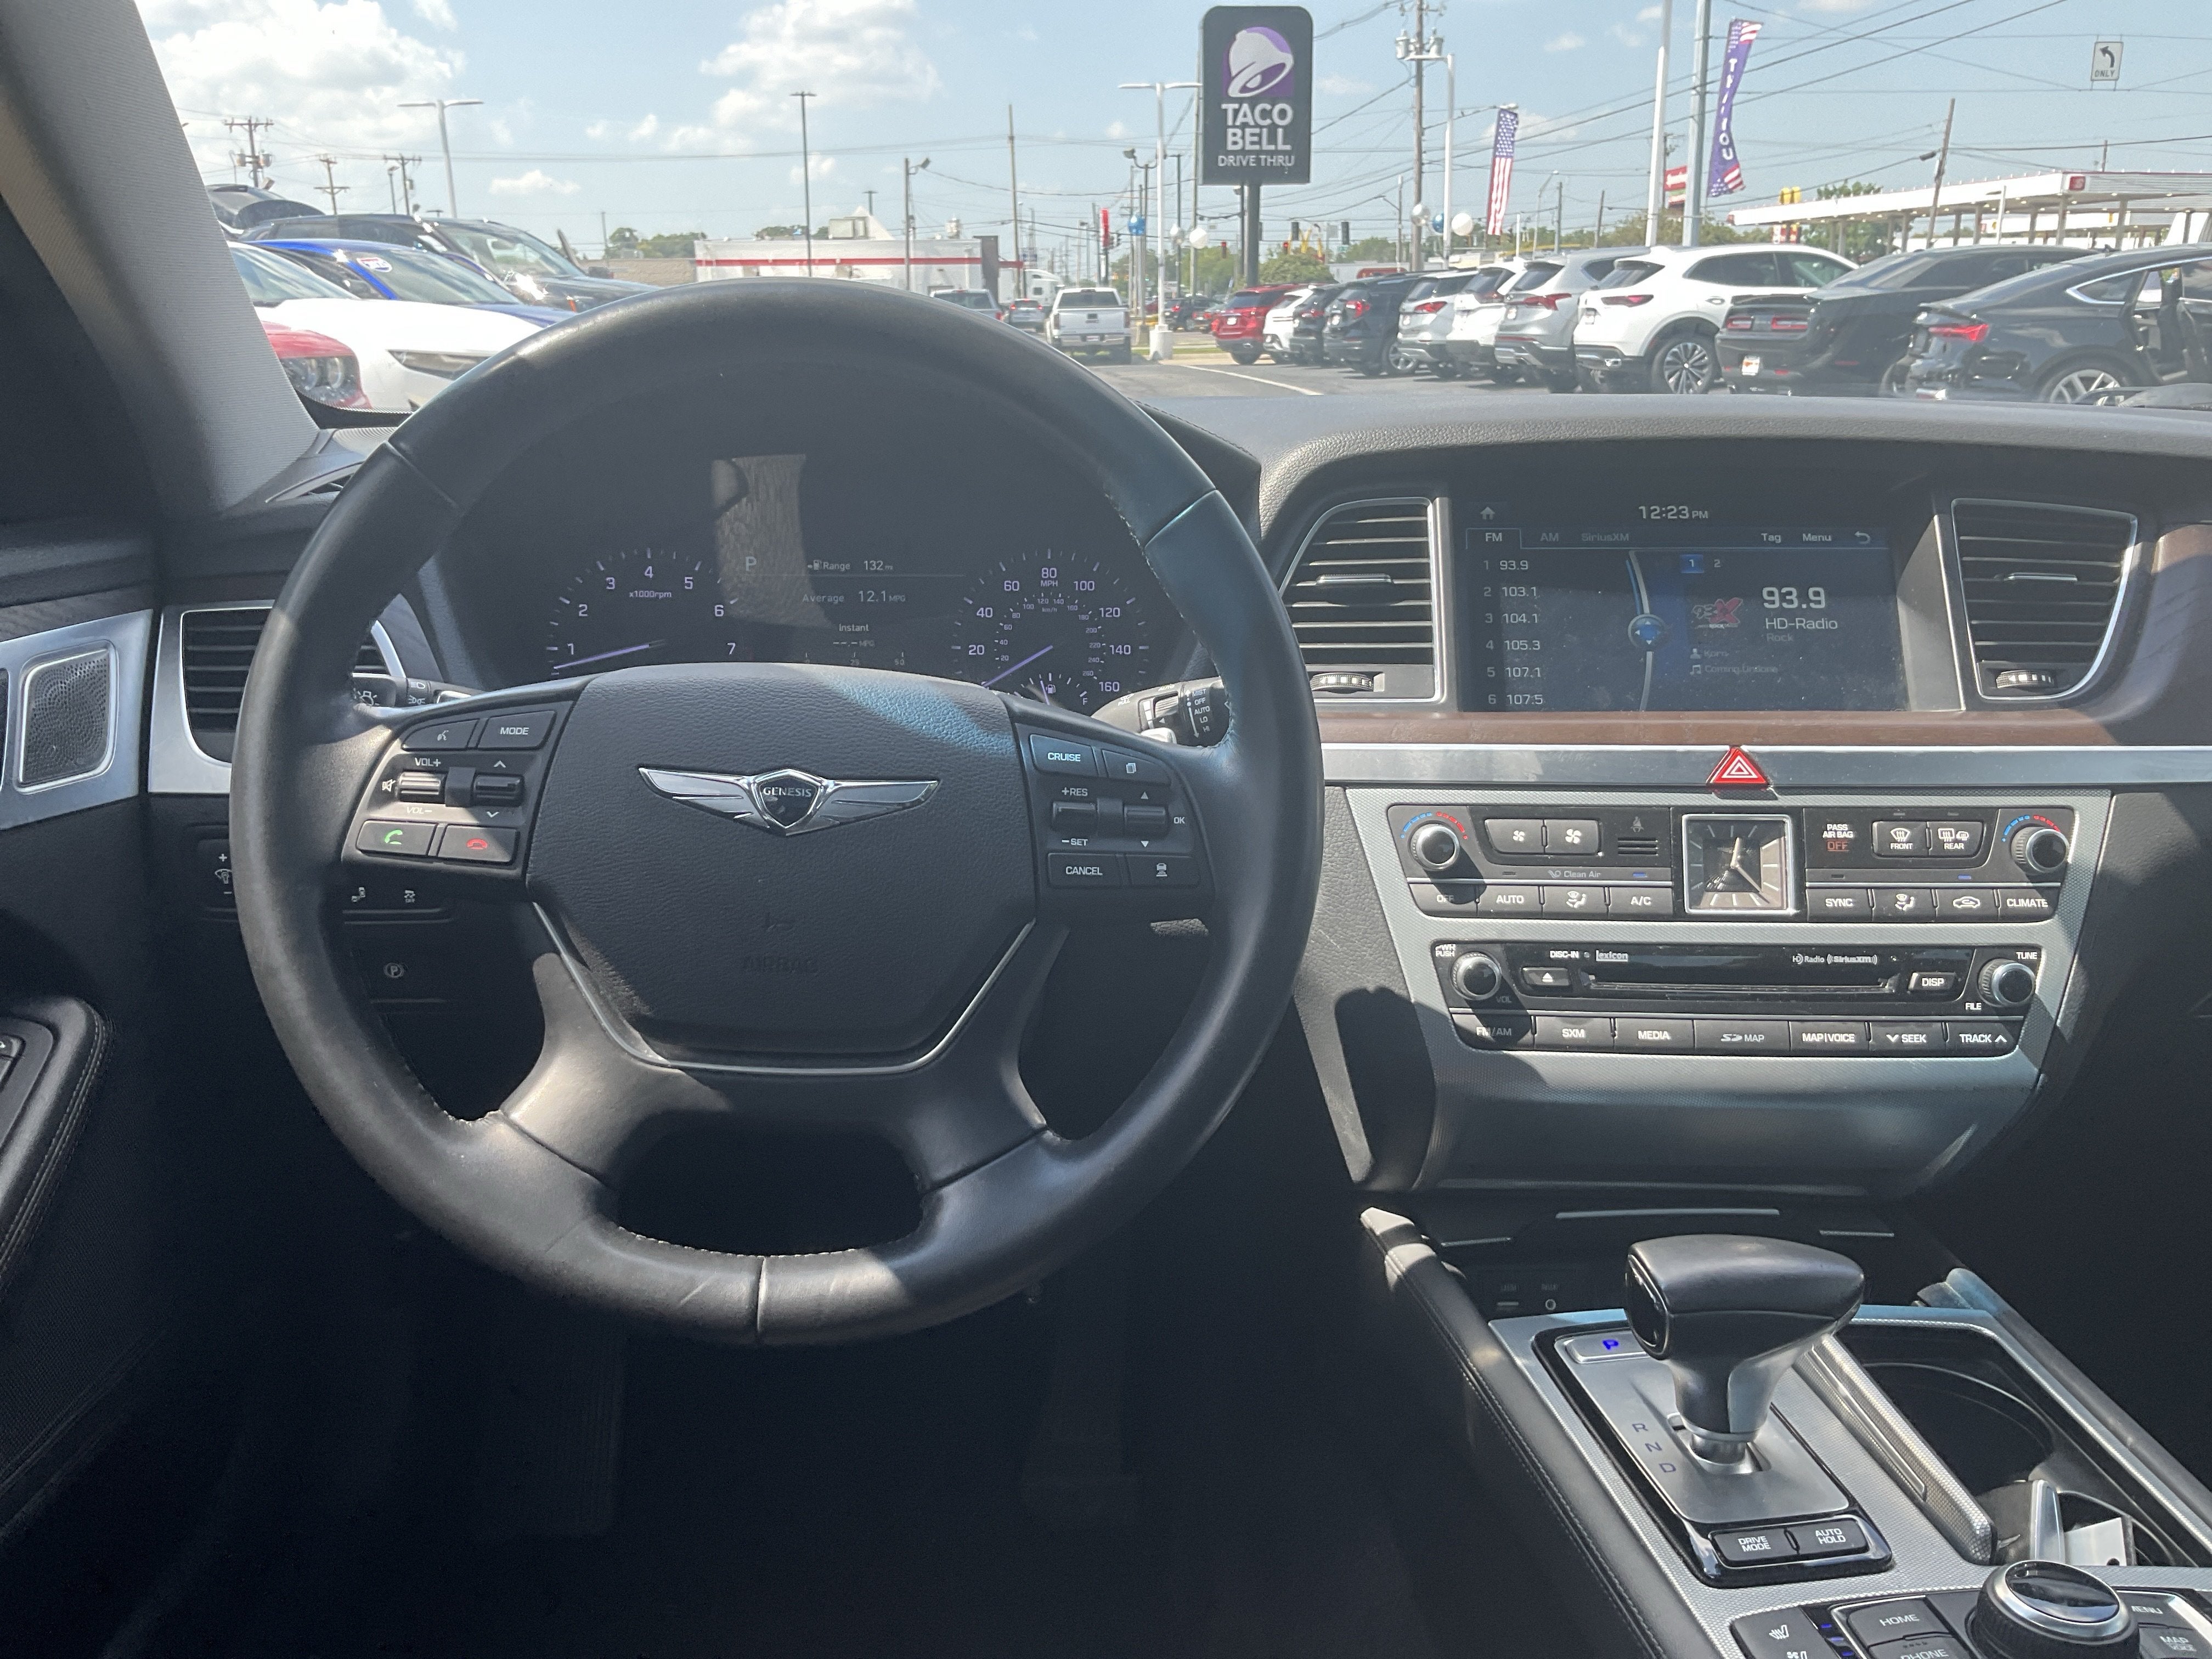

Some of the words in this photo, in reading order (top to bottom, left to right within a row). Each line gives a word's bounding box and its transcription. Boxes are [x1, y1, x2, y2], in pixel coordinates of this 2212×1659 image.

[2094, 70, 2115, 78] ONLY
[1221, 103, 1294, 126] TACO
[1226, 128, 1292, 150] BELL
[1217, 155, 1257, 167] DRIVE
[1261, 155, 1295, 167] THRU
[1638, 505, 1690, 520] 12:23
[1691, 510, 1708, 519] PM
[1485, 532, 1503, 542] FM
[1540, 532, 1559, 542] AM
[1581, 532, 1629, 542] SiriusXM
[1761, 533, 1782, 543] Tag
[1802, 533, 1832, 542] Menu
[744, 556, 757, 571] P
[823, 562, 851, 572] Range
[863, 560, 883, 571] 132
[1483, 560, 1489, 570] 1
[1499, 560, 1528, 571] 93.9
[1689, 559, 1695, 568] 1
[1714, 559, 1721, 568] 2
[644, 566, 653, 578] 4
[1041, 567, 1057, 579] 80
[606, 577, 616, 590] 3
[684, 577, 693, 590] 5
[1003, 580, 1020, 591] 60
[1073, 580, 1095, 591] 100
[629, 590, 672, 599] x1000rpm
[802, 594, 844, 603] Average
[858, 590, 887, 602] 12.1
[1483, 587, 1492, 597] 2
[1502, 586, 1537, 597] 103.1
[1762, 586, 1826, 609] 93.9
[578, 603, 588, 617] 2
[714, 604, 724, 617] 6
[976, 607, 993, 618] 40
[1099, 607, 1120, 618] 120
[1485, 613, 1493, 623] 3
[1502, 613, 1538, 624] 104.1
[1765, 617, 1838, 630] HD-Radio
[838, 623, 869, 632] Instant
[1767, 633, 1793, 642] Rock
[567, 642, 574, 655] 1
[726, 642, 736, 655] 7
[1109, 644, 1131, 655] 140
[1486, 640, 1494, 650] 4
[1504, 640, 1541, 650] 105.3
[968, 645, 985, 656] 20
[1487, 667, 1495, 677] 5
[1504, 667, 1541, 678] 107.1
[1099, 681, 1120, 692] 160
[1192, 688, 1207, 698] MIST
[1082, 697, 1088, 706] F
[1194, 697, 1206, 706] OFF
[1488, 695, 1496, 704] 6
[1506, 694, 1543, 705] 107.5
[1194, 706, 1210, 715] AUTO
[1199, 715, 1208, 724] LO
[500, 726, 529, 736] MODE
[1047, 752, 1081, 762] CRUISE
[763, 786, 812, 798] GENESIS
[1173, 816, 1186, 825] OK
[1827, 840, 1849, 850] OFF
[1065, 866, 1103, 876] CANCEL
[1563, 870, 1585, 878] Clean
[1588, 870, 1602, 878] Air
[1436, 894, 1455, 904] OFF
[1496, 894, 1524, 904] AUTO
[1630, 896, 1651, 906] A/C
[1825, 898, 1853, 907] SYNC
[2006, 898, 2049, 908] CLIMATE
[1595, 950, 1628, 962] lexicon
[1921, 978, 1944, 986] DISP
[1965, 1002, 1982, 1011] FILE
[1476, 1027, 1512, 1036] FM/AM
[1562, 1029, 1585, 1038] SXM
[1638, 1030, 1669, 1040] MEDIA
[1901, 1034, 1926, 1043] SEEK
[1959, 1034, 1992, 1043] TRACK
[1602, 1339, 1619, 1350] P
[1632, 1423, 1649, 1432] R
[1645, 1442, 1662, 1452] N
[1659, 1463, 1677, 1473] D
[1815, 1528, 1843, 1537] AUTO
[1737, 1536, 1768, 1545] DRIVE
[1818, 1535, 1846, 1544] HOLD
[1742, 1542, 1771, 1552] MODE
[1878, 1613, 1920, 1627] HOME
[2159, 1635, 2190, 1644] MAP
